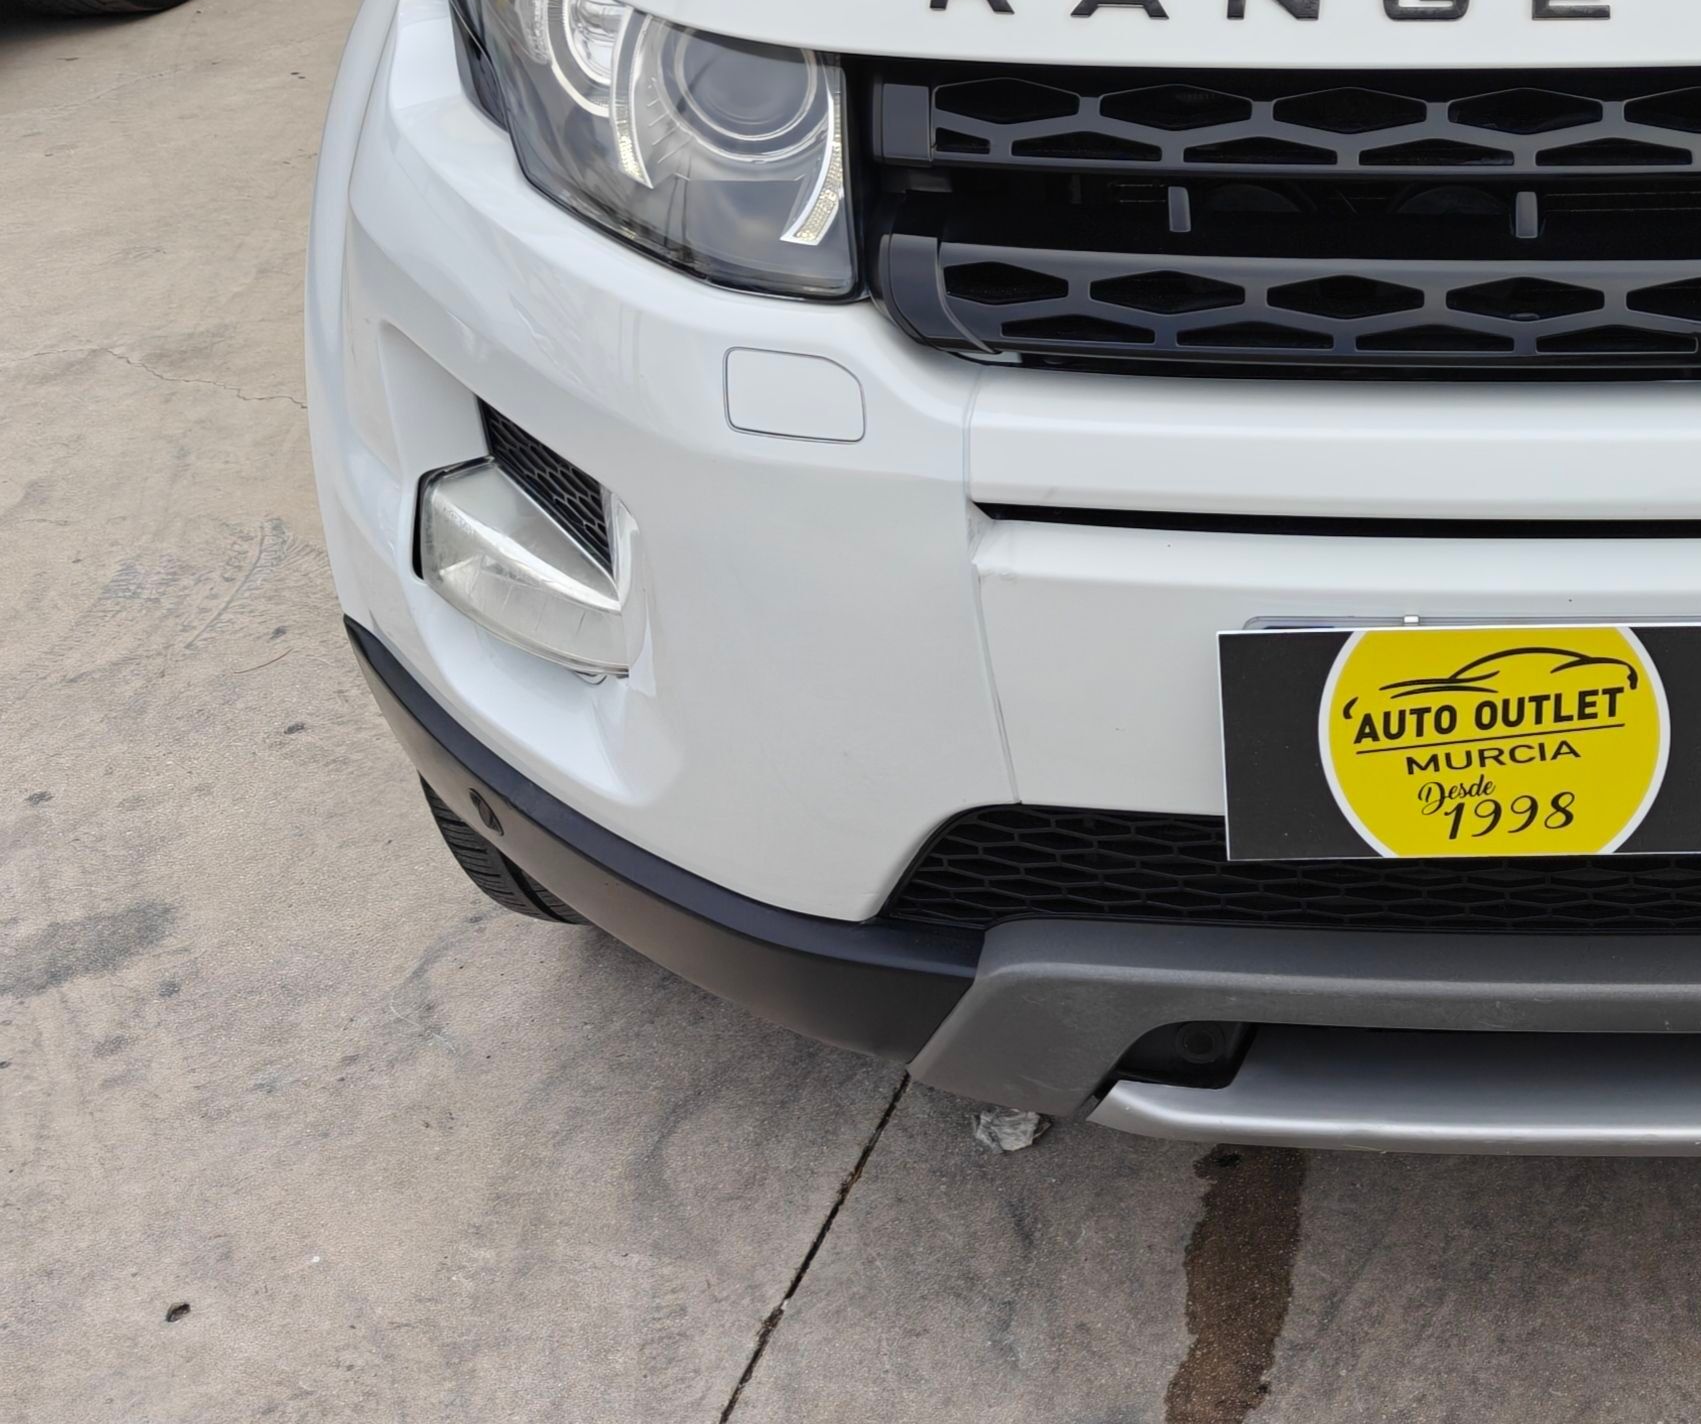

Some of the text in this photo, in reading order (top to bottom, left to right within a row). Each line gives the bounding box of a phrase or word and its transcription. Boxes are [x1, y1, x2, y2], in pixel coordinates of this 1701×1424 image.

[1353, 686, 1625, 745] AUTO OUTLET
[1406, 740, 1581, 775] MURCIA
[1417, 774, 1496, 816] Desde
[1443, 791, 1576, 840] 1998
